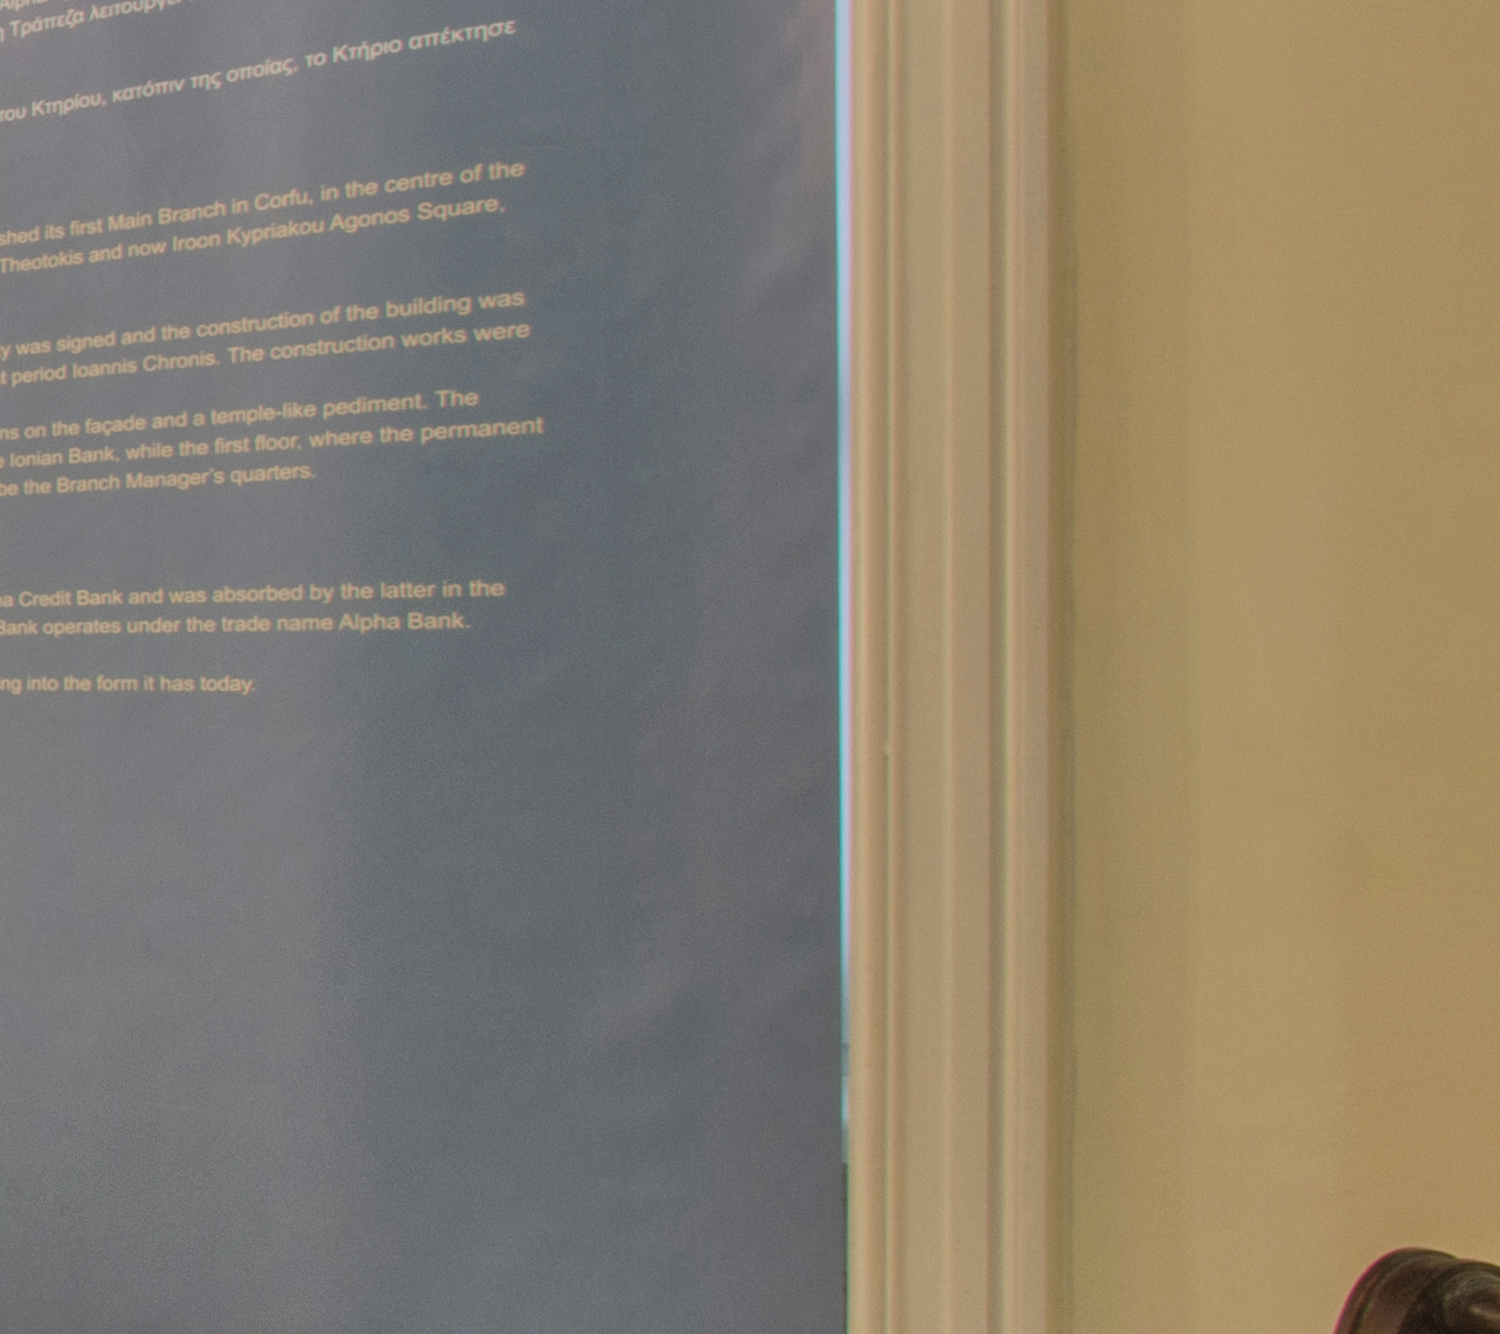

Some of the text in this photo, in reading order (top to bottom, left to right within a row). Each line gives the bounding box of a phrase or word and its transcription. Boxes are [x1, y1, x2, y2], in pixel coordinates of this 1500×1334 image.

[111, 77, 185, 103] κατόπιν
[188, 71, 222, 92] της
[303, 51, 327, 68] το
[331, 37, 403, 64] Κτήριο
[407, 18, 517, 51] απέκτησε
[44, 223, 65, 240] its
[69, 217, 104, 236] first
[107, 210, 152, 232] Main
[157, 199, 226, 225] Branch
[231, 196, 248, 215] in
[253, 188, 314, 210] Corfu,
[319, 184, 339, 202] in
[343, 179, 378, 198] the
[383, 170, 453, 194] centre
[459, 162, 483, 184] of
[487, 160, 526, 181] the
[23, 424, 46, 439] on
[50, 419, 80, 437] the
[83, 414, 147, 436] façade
[150, 409, 187, 429] and
[191, 412, 206, 426] a
[209, 401, 316, 426] temple-like
[321, 392, 427, 420] pediment.
[433, 388, 479, 408] The
[41, 618, 122, 638] operates
[125, 616, 182, 634] under
[184, 615, 217, 633] the
[219, 614, 271, 632] trade
[275, 617, 334, 632] name
[337, 612, 401, 635] Alpha
[407, 610, 471, 630] Bank.
[26, 674, 59, 691] into
[61, 674, 93, 691] the
[95, 674, 138, 692] form
[143, 673, 156, 692] it
[159, 674, 195, 691] has
[198, 674, 257, 696] today.
